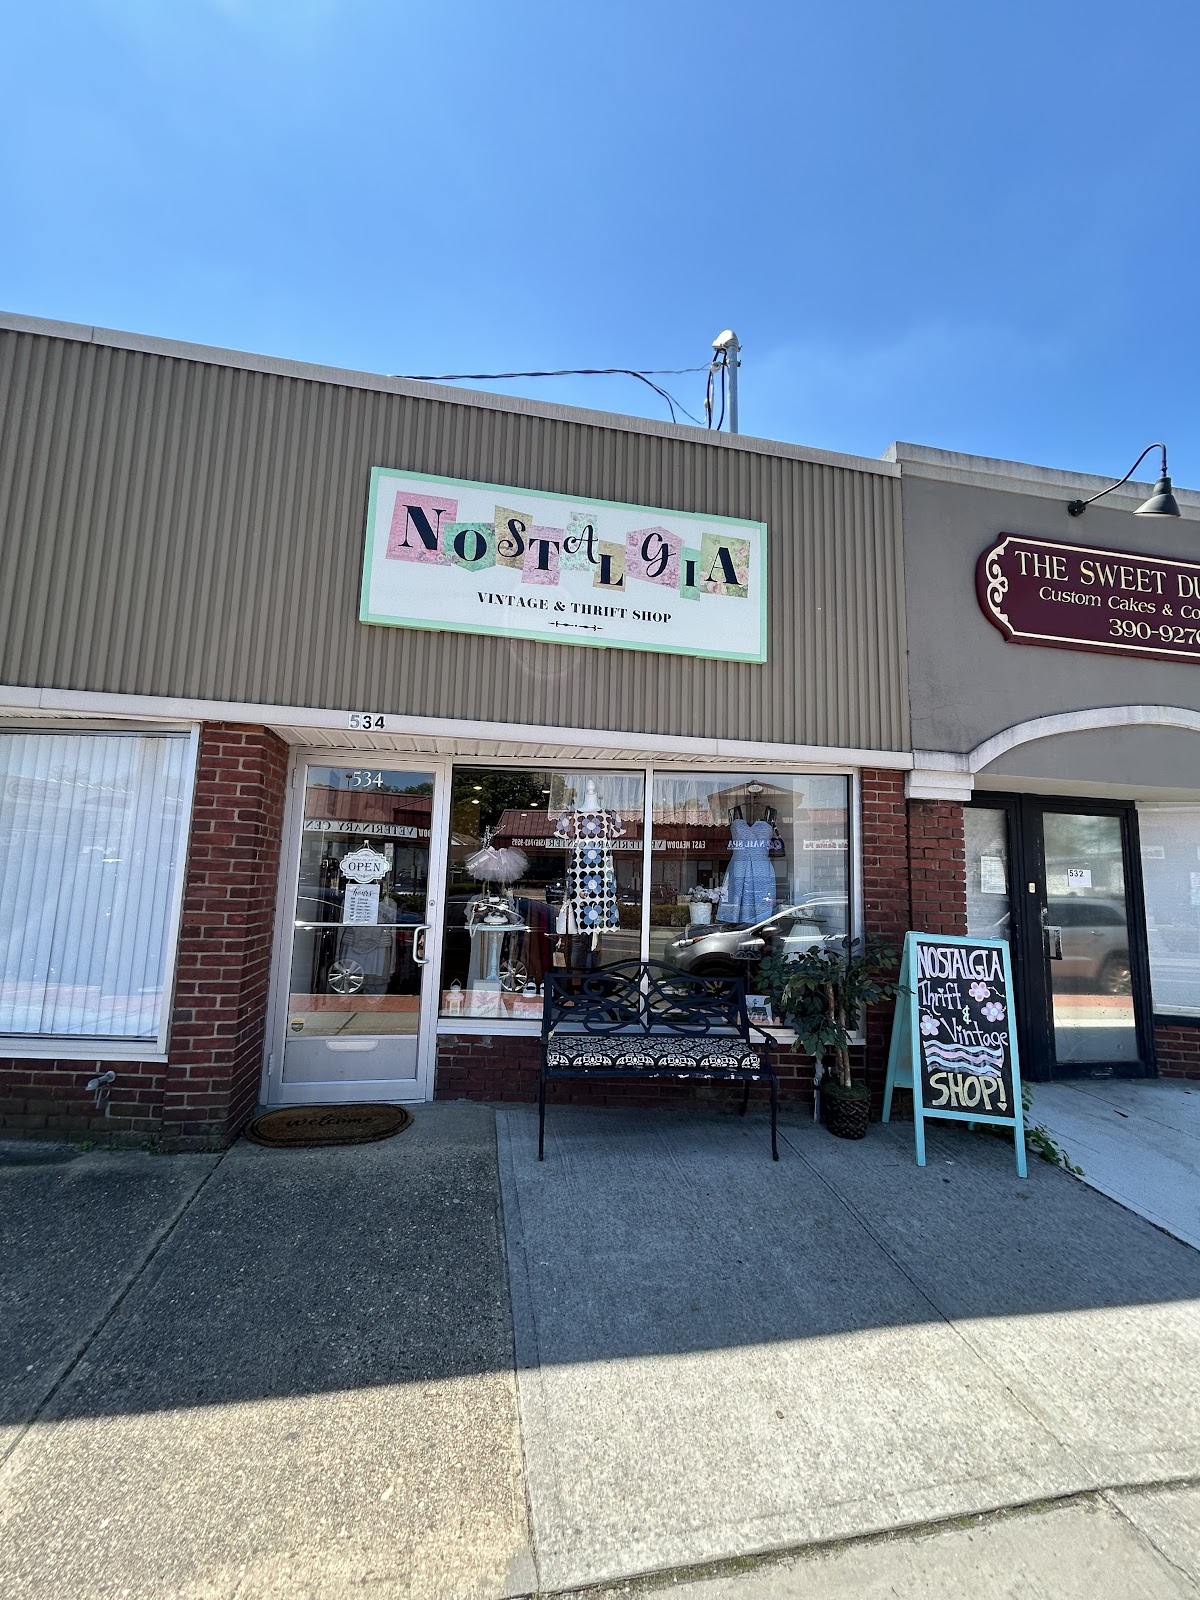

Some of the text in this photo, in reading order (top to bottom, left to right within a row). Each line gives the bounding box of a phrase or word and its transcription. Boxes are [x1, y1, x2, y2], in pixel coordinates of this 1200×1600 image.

[1014, 550, 1069, 582] THE
[1080, 560, 1167, 595] SWEET
[478, 591, 672, 624] VINTAGE & THRIFT SHOP
[1039, 586, 1101, 607] Custom
[1108, 595, 1156, 614] Cakes
[1162, 603, 1174, 617] &
[350, 714, 385, 730] 534
[352, 770, 384, 788] 534
[348, 861, 382, 872] OPEN
[1069, 869, 1084, 877] 532
[917, 945, 1004, 982] NOSTALGIA
[918, 980, 962, 1014] Thrift
[940, 1017, 1008, 1060] Vintage
[930, 1072, 1008, 1112] SHOP!
[285, 1113, 377, 1128] welcome
